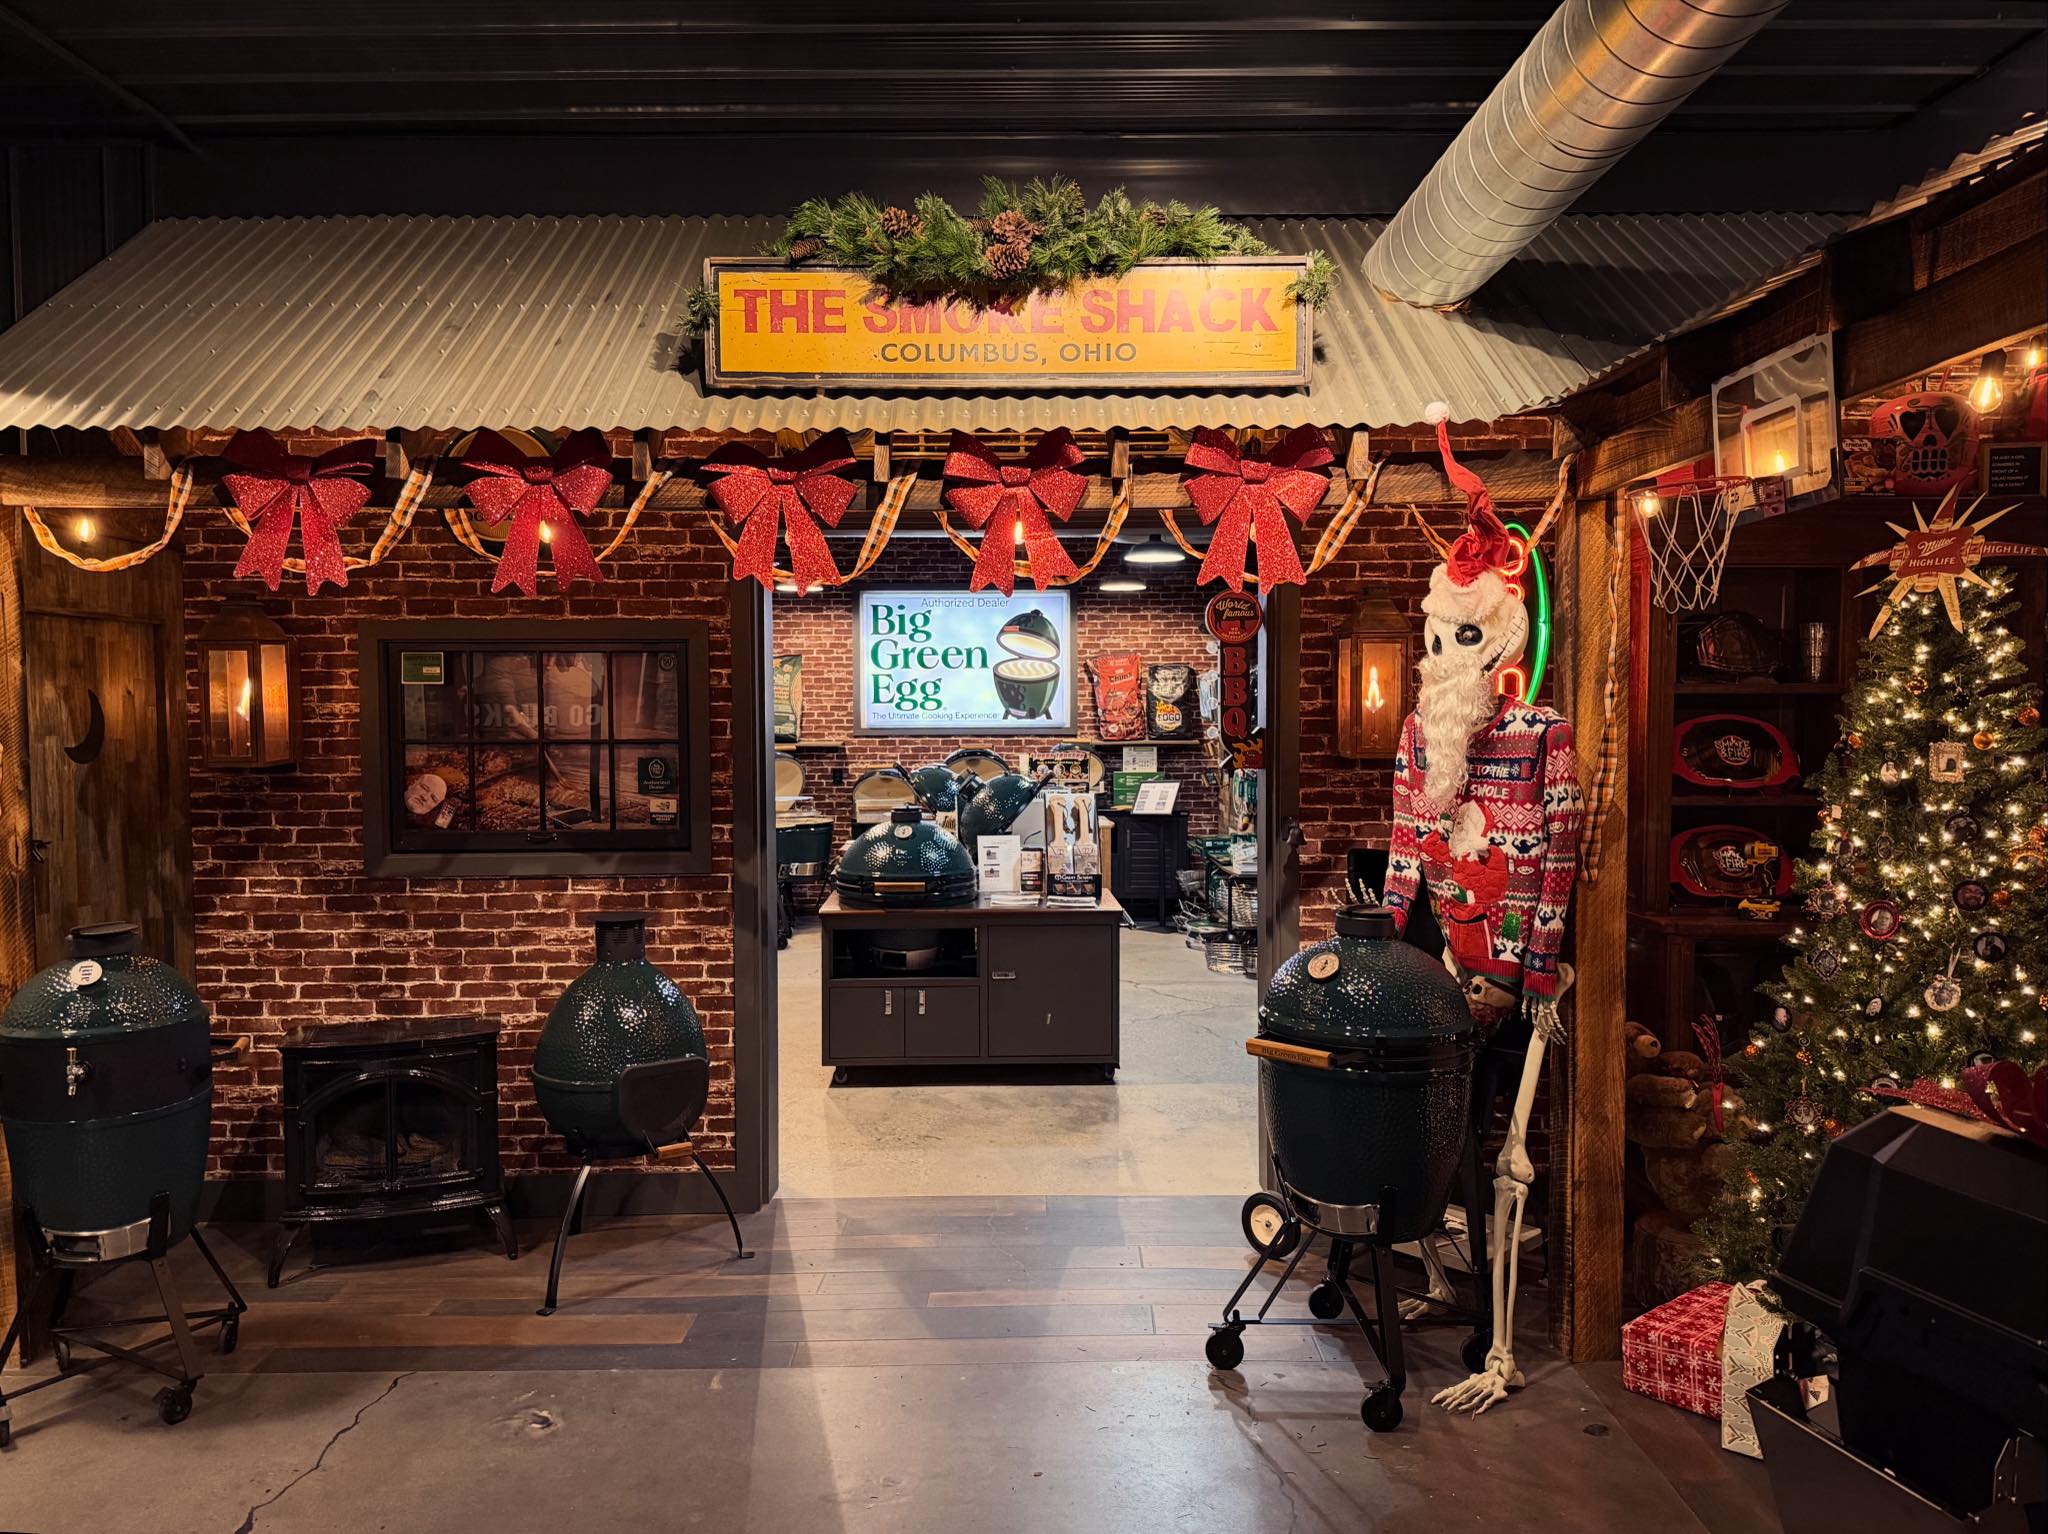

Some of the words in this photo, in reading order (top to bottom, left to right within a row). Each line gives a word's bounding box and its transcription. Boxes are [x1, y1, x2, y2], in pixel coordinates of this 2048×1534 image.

[734, 288, 846, 334] THE
[863, 289, 1065, 334] SMOKE
[1080, 287, 1280, 334] SHACK
[880, 342, 1047, 367] COLUMBUS,
[1059, 342, 1137, 363] OHIO
[1917, 536, 1957, 557] Miller
[1983, 545, 2011, 553] HIGH
[2013, 545, 2038, 555] LIFE
[1909, 558, 1934, 567] HIGH
[1934, 557, 1956, 565] LIFE
[921, 598, 975, 608] Authorized
[978, 598, 1009, 608] Dealer
[1215, 598, 1252, 611] World
[1222, 608, 1254, 620] famous
[871, 604, 932, 643] Big
[870, 638, 990, 670] Green
[871, 673, 943, 711] Egg
[1223, 646, 1248, 738] BBQ
[872, 712, 887, 720] The
[888, 712, 920, 720] Ultimate
[921, 712, 954, 721] Cooking
[1492, 764, 1510, 777] THE
[1469, 783, 1510, 799] SWOLE
